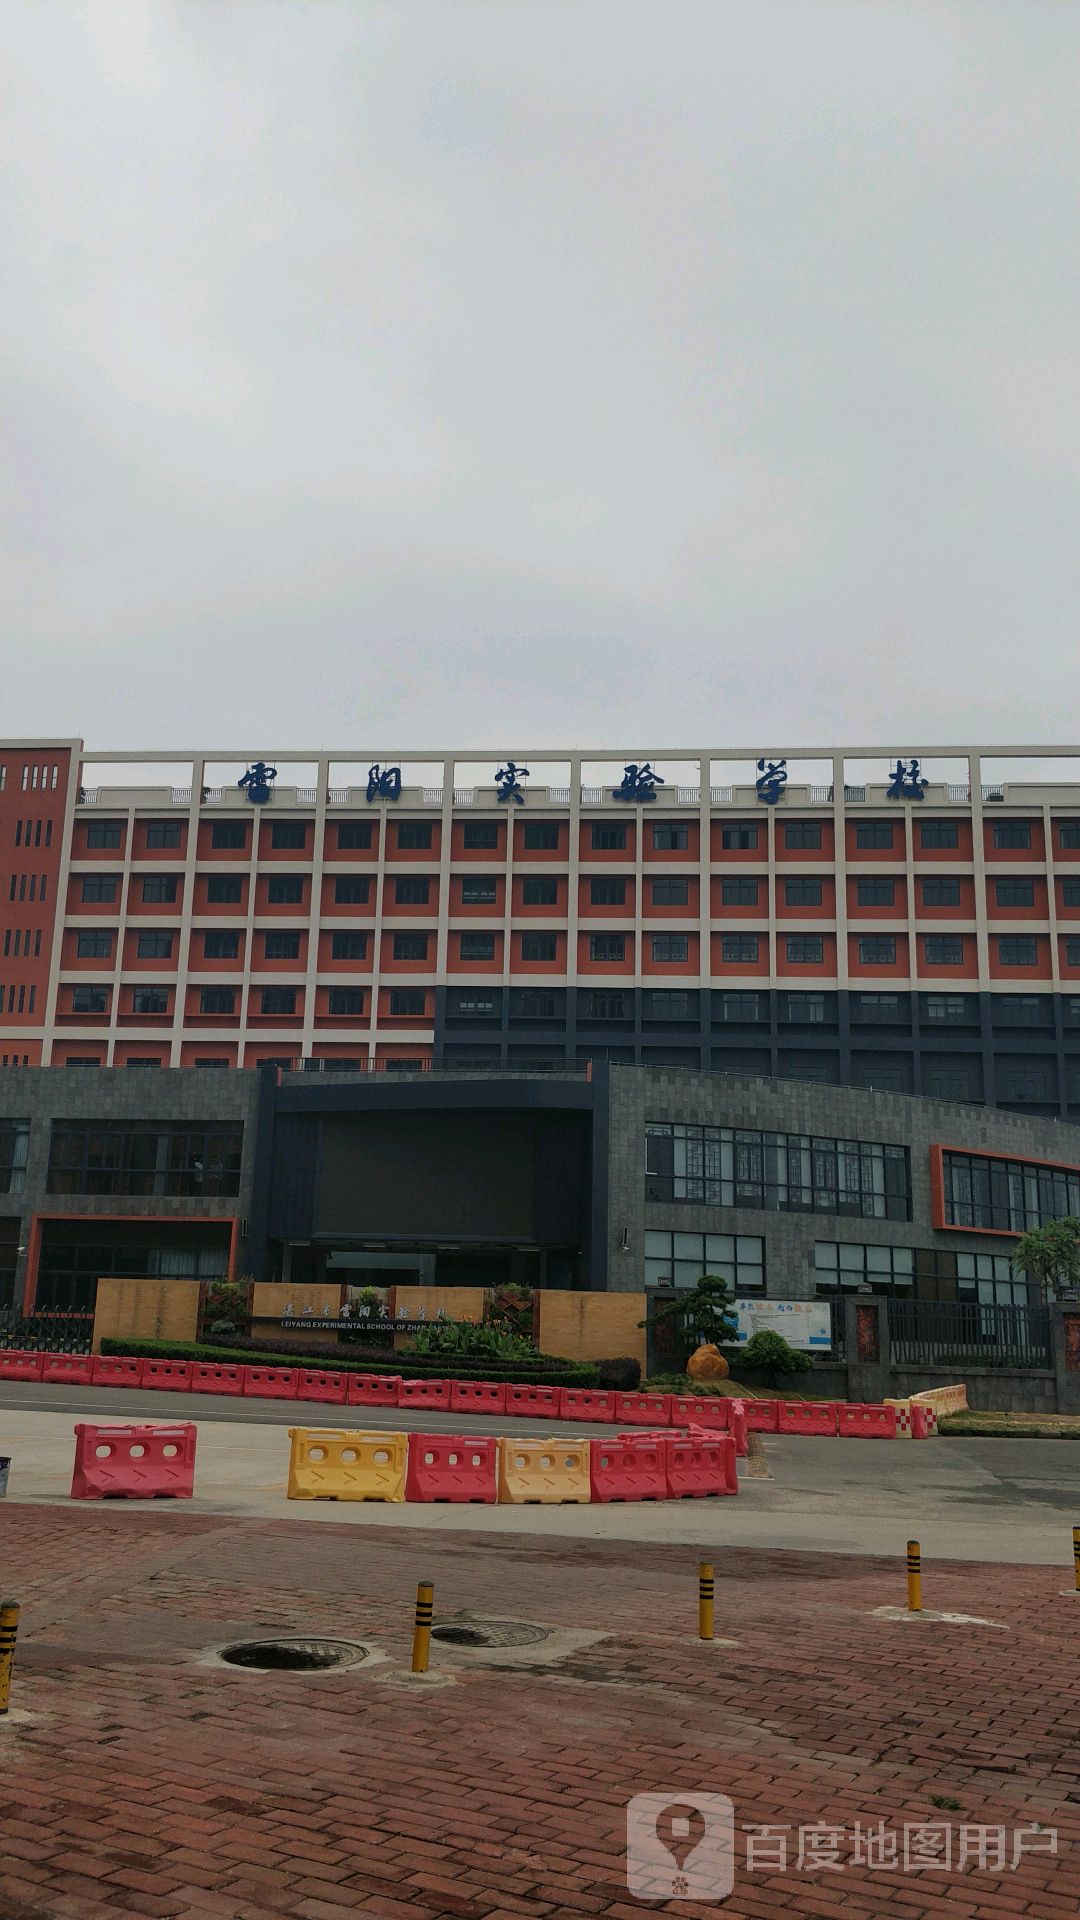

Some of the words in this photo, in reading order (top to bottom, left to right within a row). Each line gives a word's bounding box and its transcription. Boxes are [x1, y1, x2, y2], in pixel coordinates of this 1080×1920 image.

[238, 758, 929, 805] 雷阳实验学校
[282, 1303, 448, 1320] 湛江市雷阳实验学校
[281, 1320, 311, 1328] LEIYANG
[312, 1321, 366, 1329] EXPERIMENTAL
[396, 1323, 406, 1331] OF
